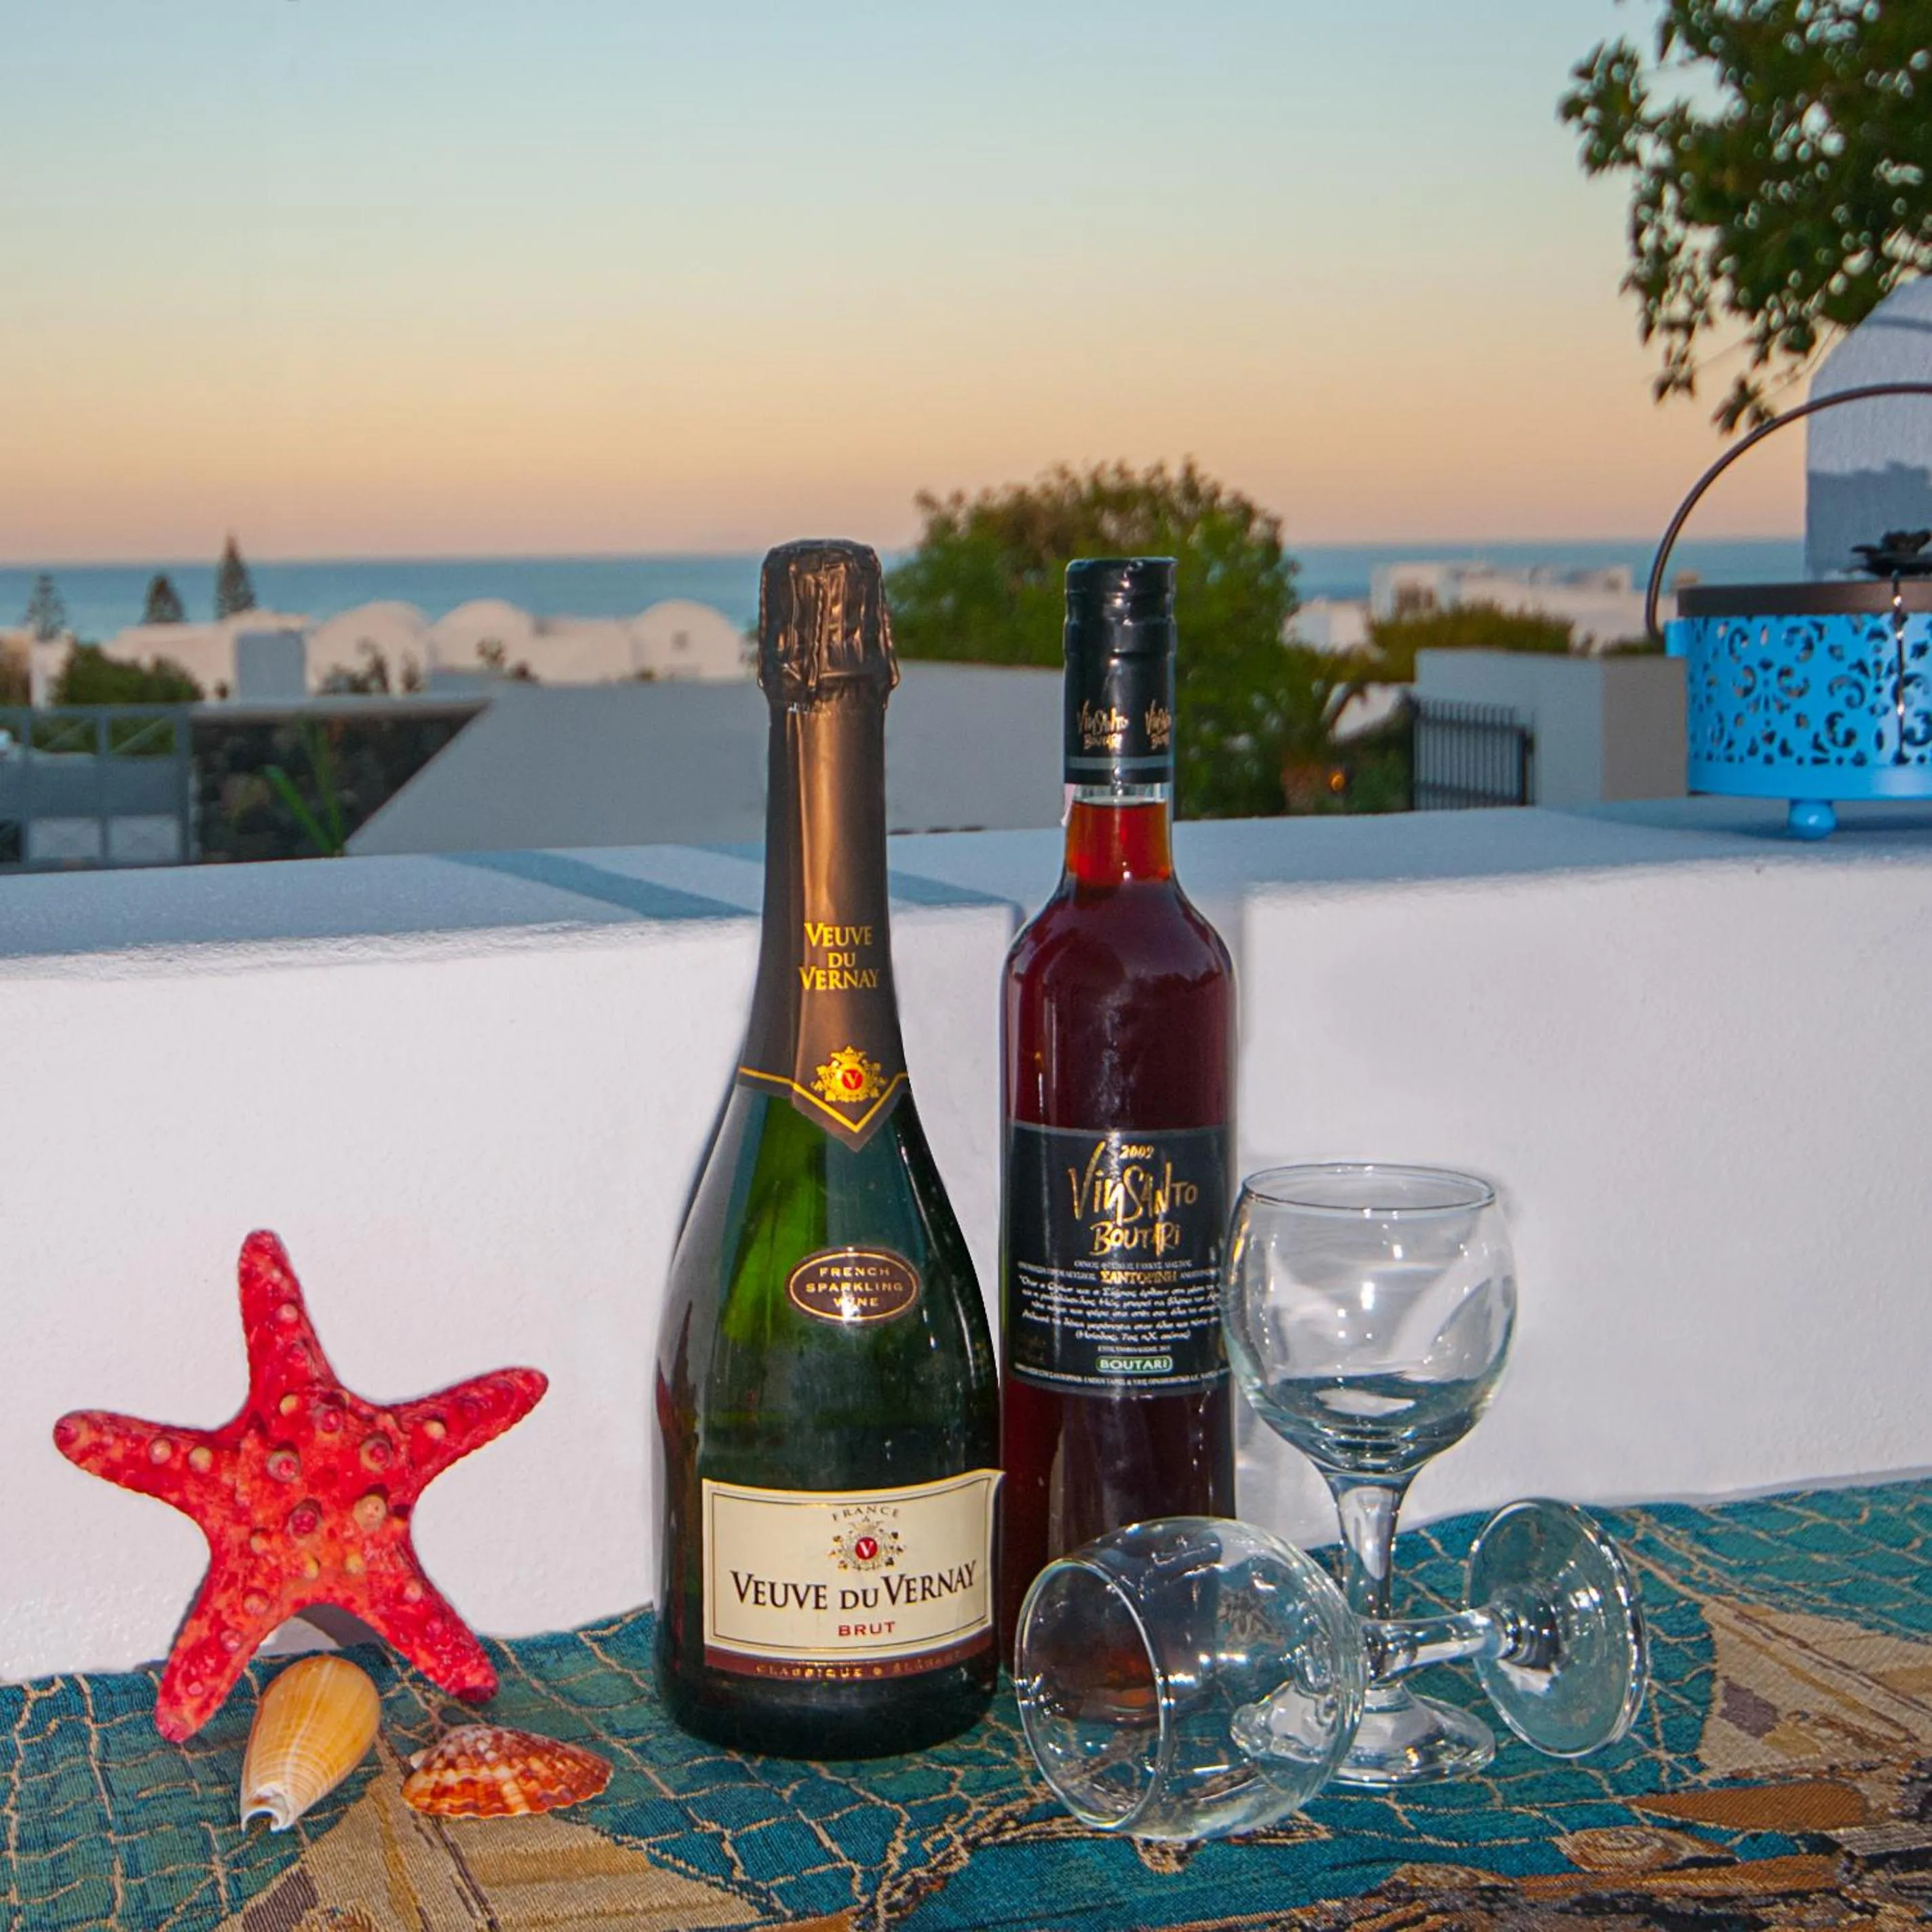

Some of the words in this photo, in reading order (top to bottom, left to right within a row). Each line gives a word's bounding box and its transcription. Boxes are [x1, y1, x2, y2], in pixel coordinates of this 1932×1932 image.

[804, 923, 873, 946] VEUVE
[828, 952, 856, 968] DU
[798, 966, 880, 990] VERNAY
[819, 1267, 890, 1277] FRENCH
[805, 1281, 904, 1293] SPARKLING
[832, 1505, 900, 1522] FRANCE
[729, 1569, 828, 1610] VEUVE
[839, 1587, 878, 1610] DU
[880, 1560, 977, 1606] VERNAY
[838, 1621, 896, 1637] BRUT
